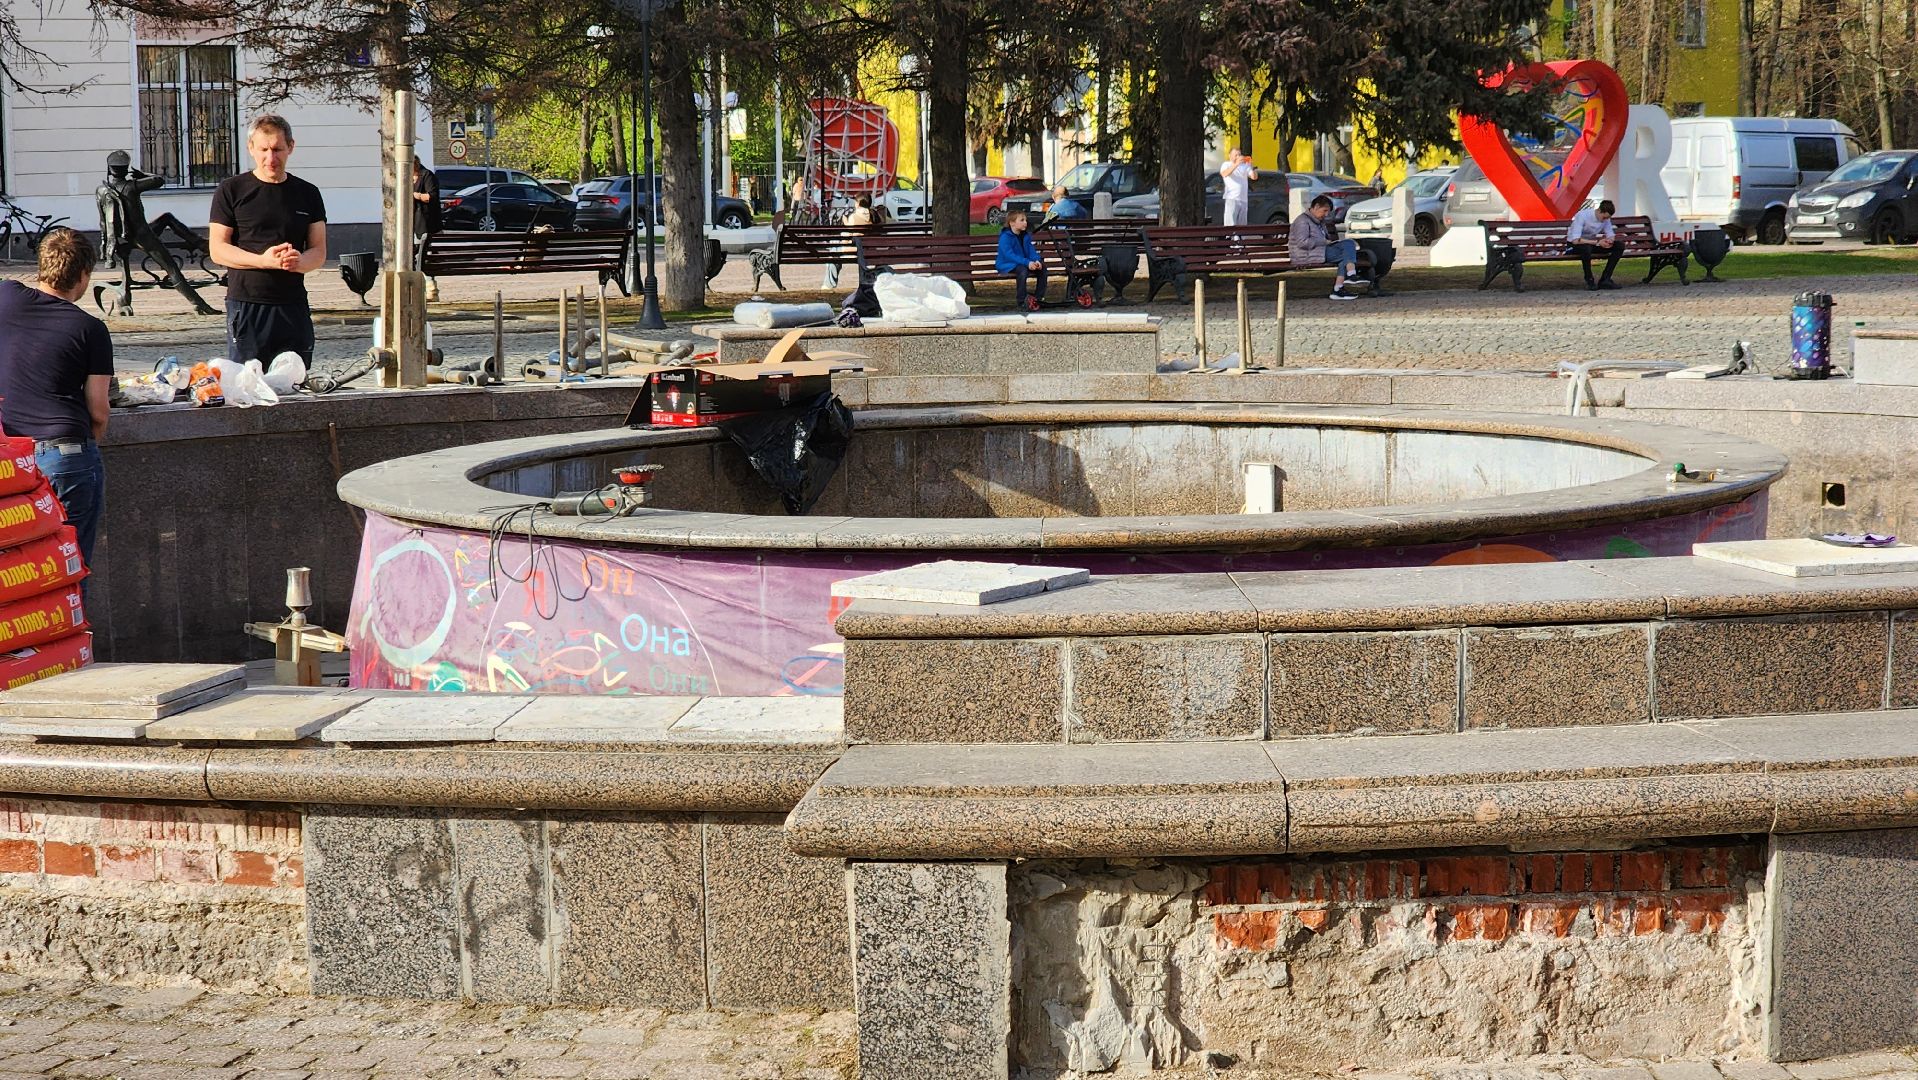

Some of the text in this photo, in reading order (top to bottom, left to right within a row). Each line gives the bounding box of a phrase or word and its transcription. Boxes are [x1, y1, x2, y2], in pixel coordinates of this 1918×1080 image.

[453, 146, 464, 154] 20
[661, 373, 686, 382] Einhell
[0, 562, 39, 588] ПЛЮС
[582, 555, 636, 596] Он
[522, 570, 547, 618] Я
[12, 610, 49, 636] ПЛЮС
[620, 613, 690, 656] Она
[650, 664, 709, 693] Они
